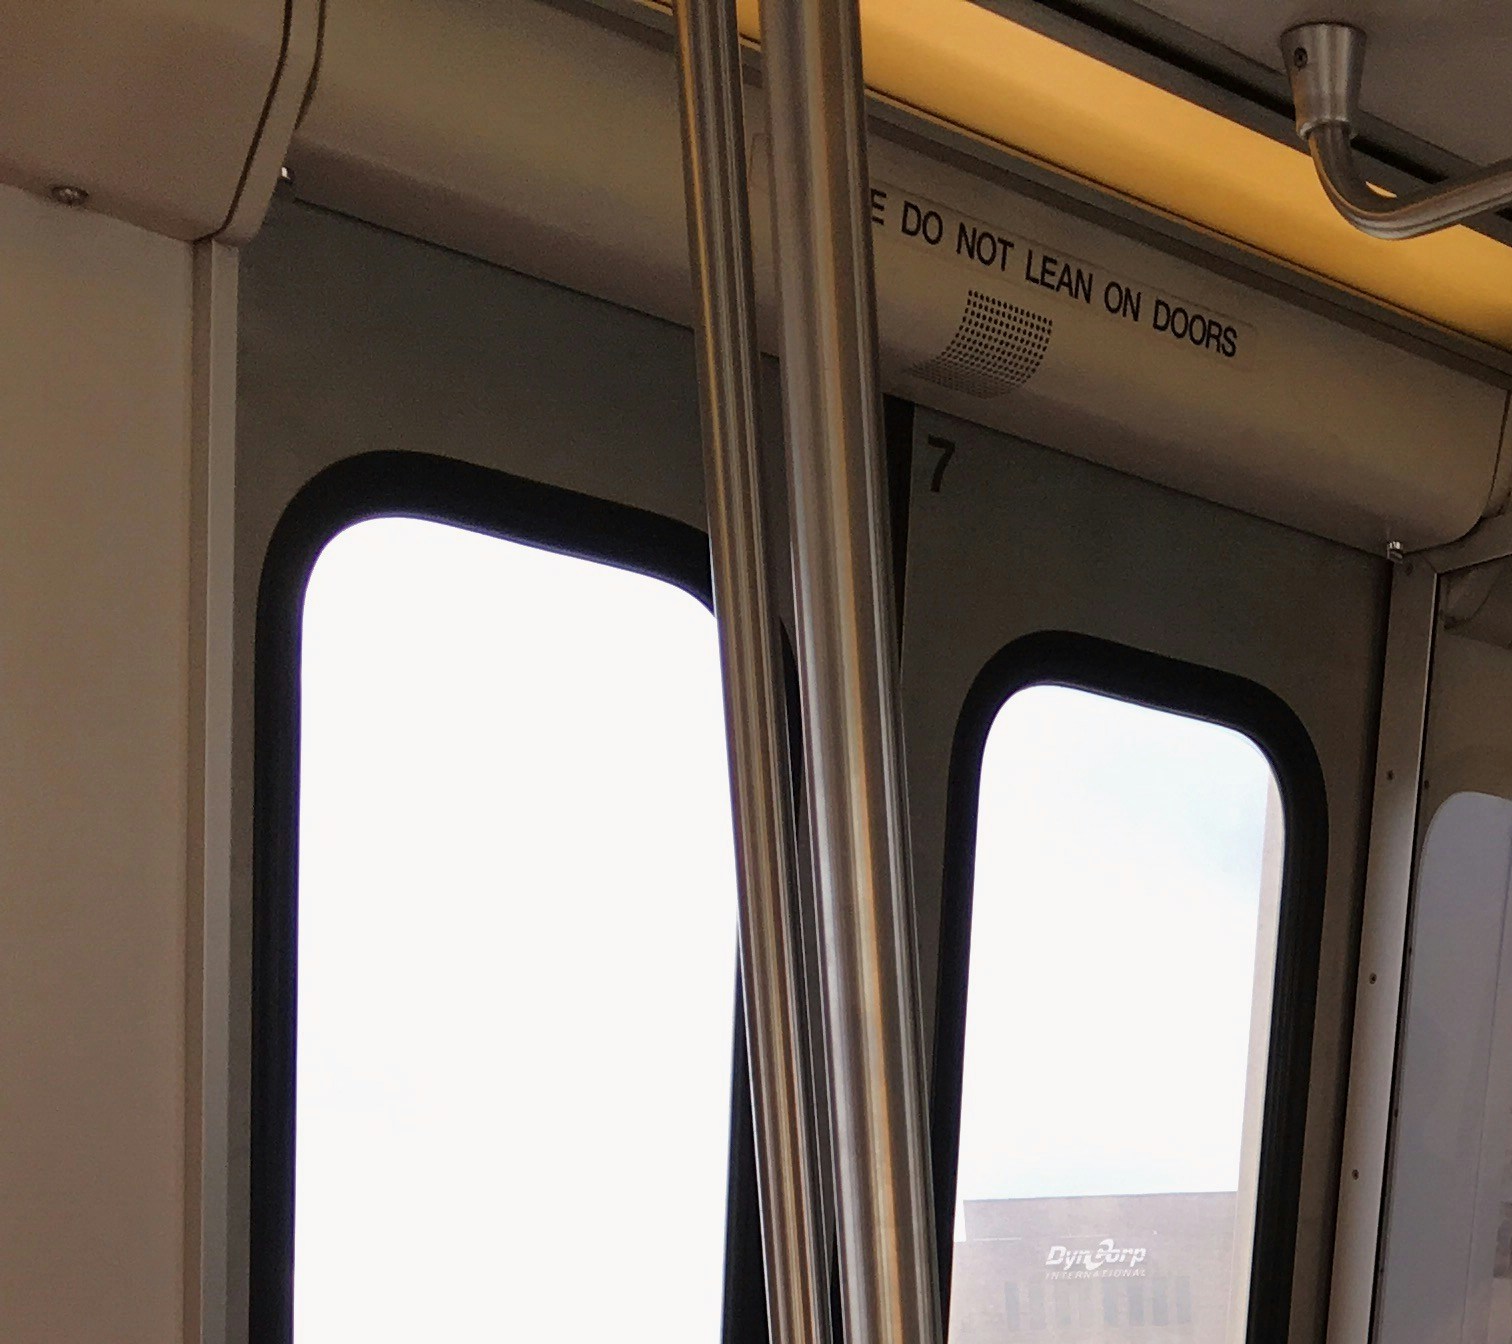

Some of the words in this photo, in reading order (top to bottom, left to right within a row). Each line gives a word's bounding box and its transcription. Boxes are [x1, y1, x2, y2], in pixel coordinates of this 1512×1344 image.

[901, 202, 944, 246] DO
[956, 221, 1015, 272] NOT
[1025, 248, 1094, 304] LEAN
[1104, 280, 1142, 322] ON
[1152, 299, 1238, 358] DOORS
[926, 434, 956, 493] 7
[1045, 1268, 1147, 1281] INTERNATIONAL
